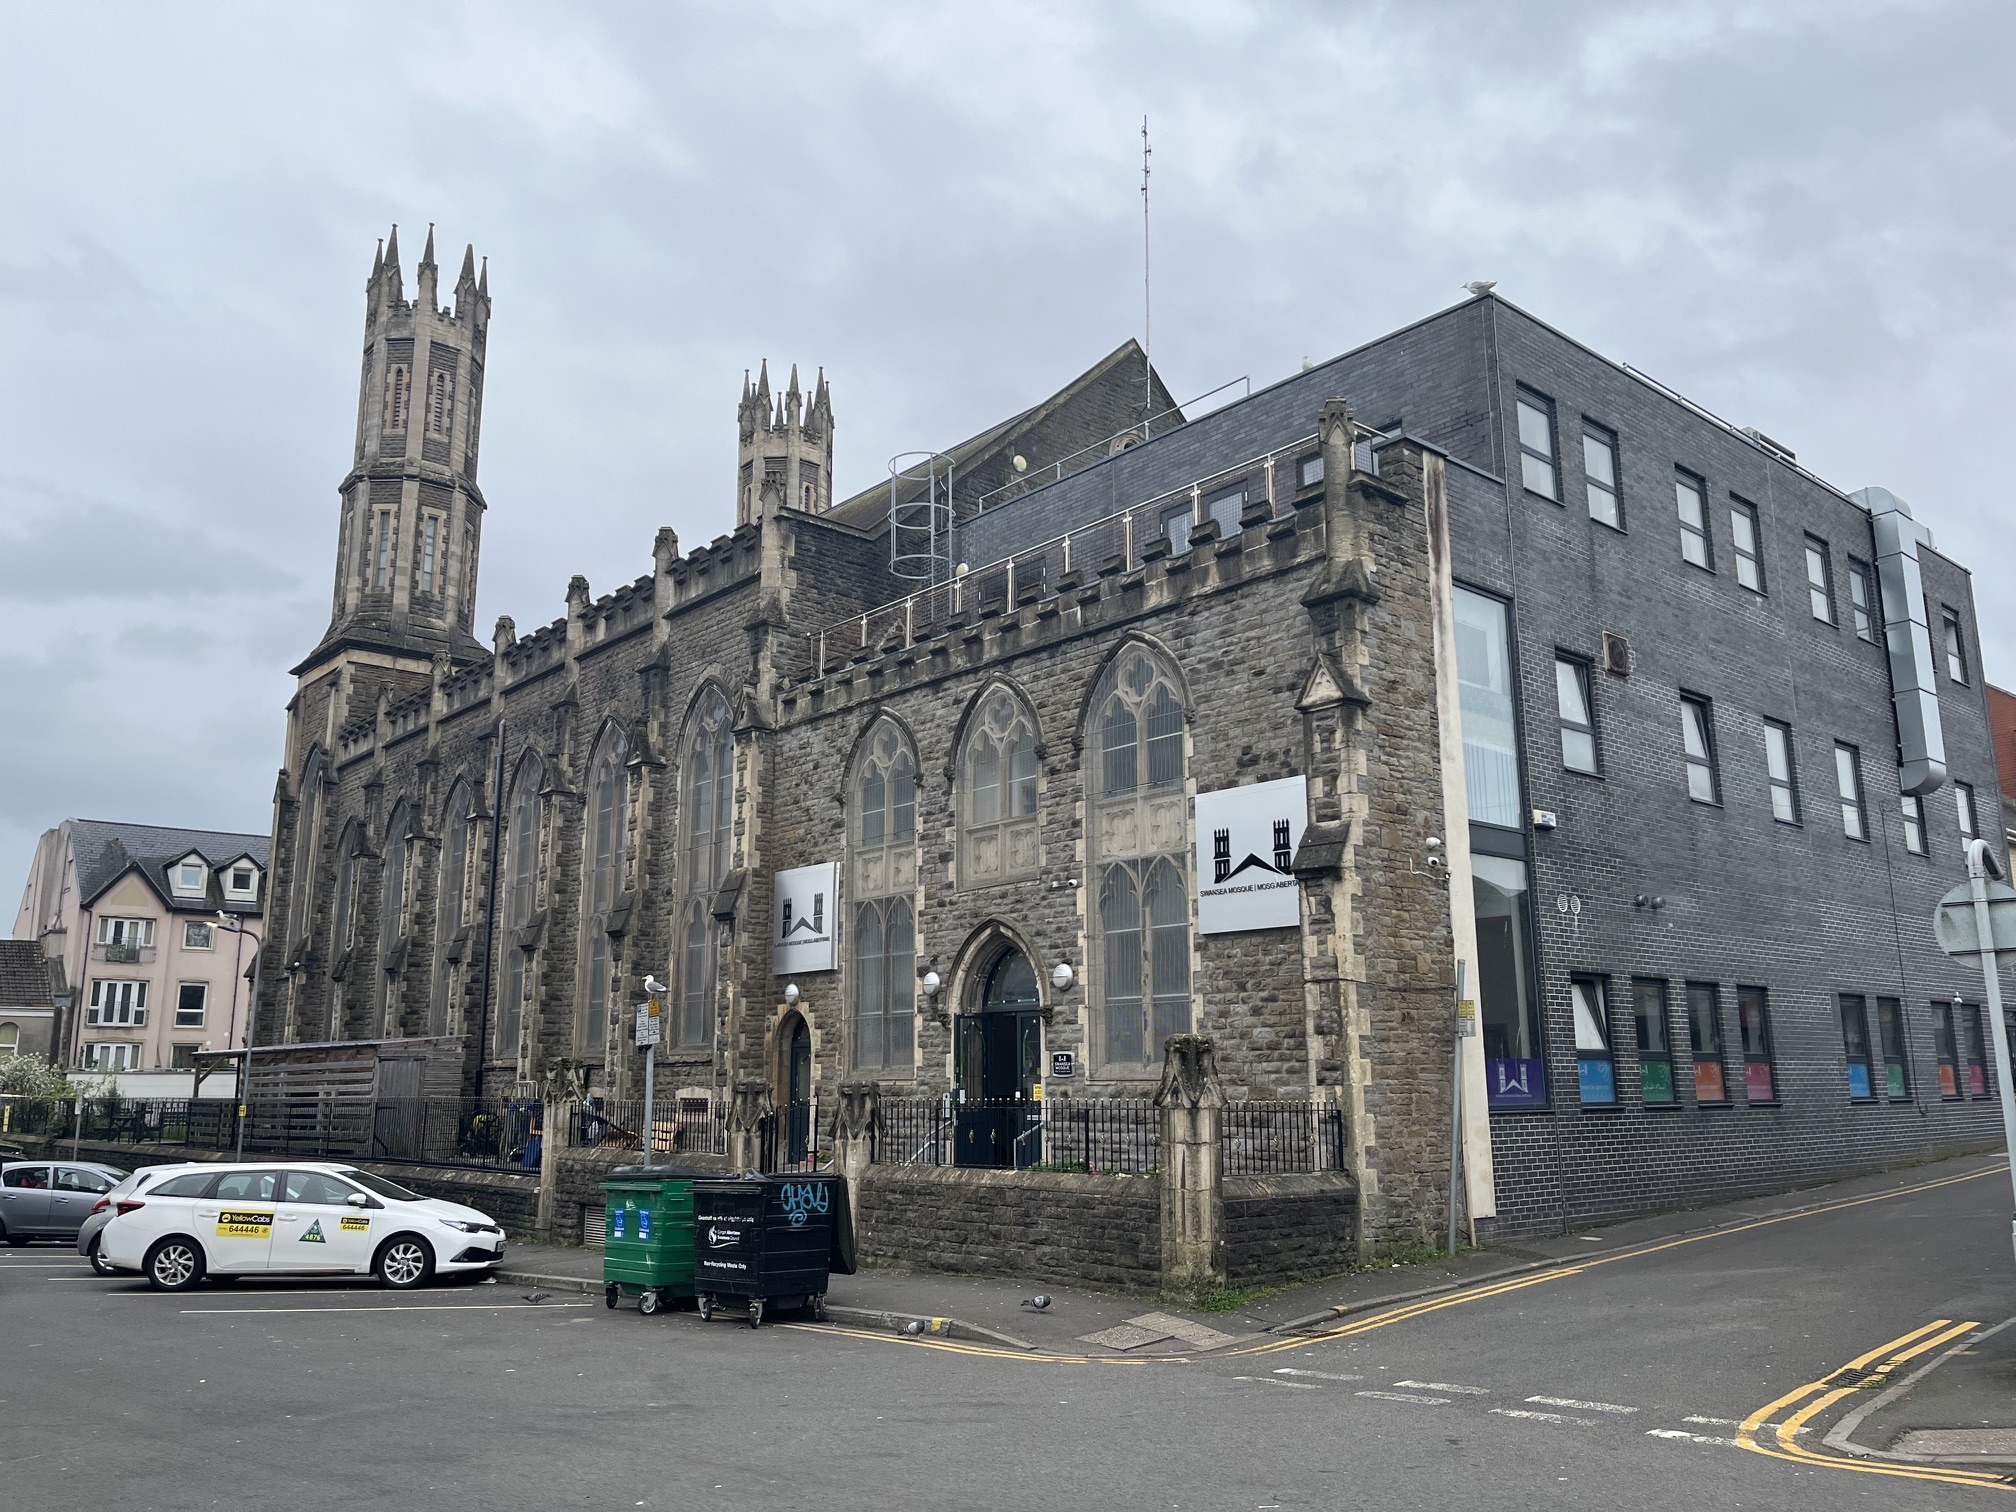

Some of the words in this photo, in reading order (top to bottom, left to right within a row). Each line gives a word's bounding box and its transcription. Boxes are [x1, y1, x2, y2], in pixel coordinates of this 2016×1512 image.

[1200, 888, 1228, 897] SWANSEA
[1228, 884, 1253, 894] MOSQUE
[1257, 881, 1275, 890] MOSG
[1276, 879, 1300, 889] ABERTA
[229, 1225, 260, 1234] 644446
